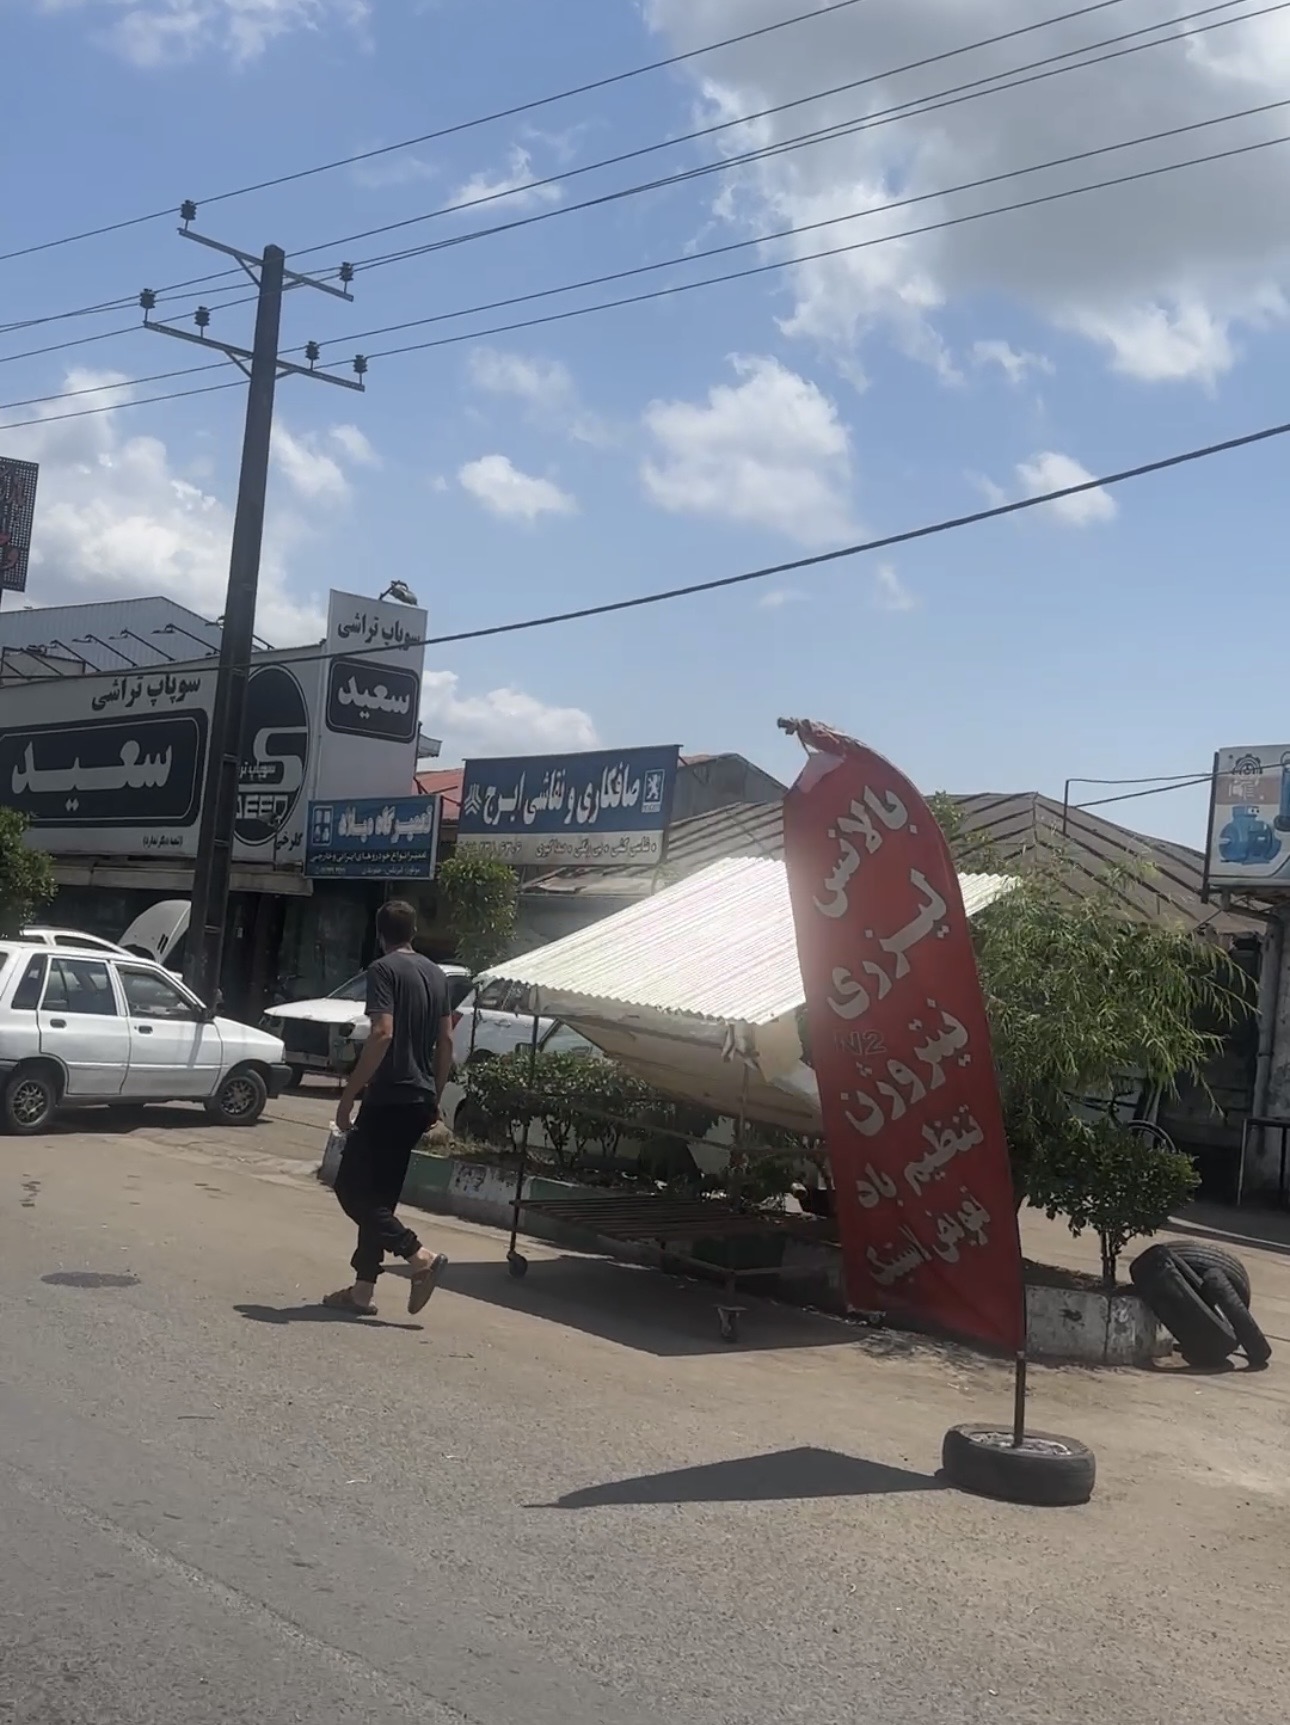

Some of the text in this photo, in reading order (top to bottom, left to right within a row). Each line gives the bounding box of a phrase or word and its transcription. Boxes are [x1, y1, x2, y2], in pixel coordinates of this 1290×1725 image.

[337, 612, 380, 643] تراشی
[91, 673, 201, 711] سوپاپ تراشی
[337, 676, 411, 720] سعید
[11, 740, 173, 812] سعید
[523, 769, 566, 825] نقاشی
[563, 786, 576, 825] و
[576, 762, 641, 824] صافکاری
[812, 785, 918, 918] بالانس
[826, 867, 950, 1020] لیزری
[840, 997, 972, 1137] نیتروژن
[855, 1104, 985, 1209] تنظیم باد
[866, 1185, 991, 1286] تعویض لاستیک
